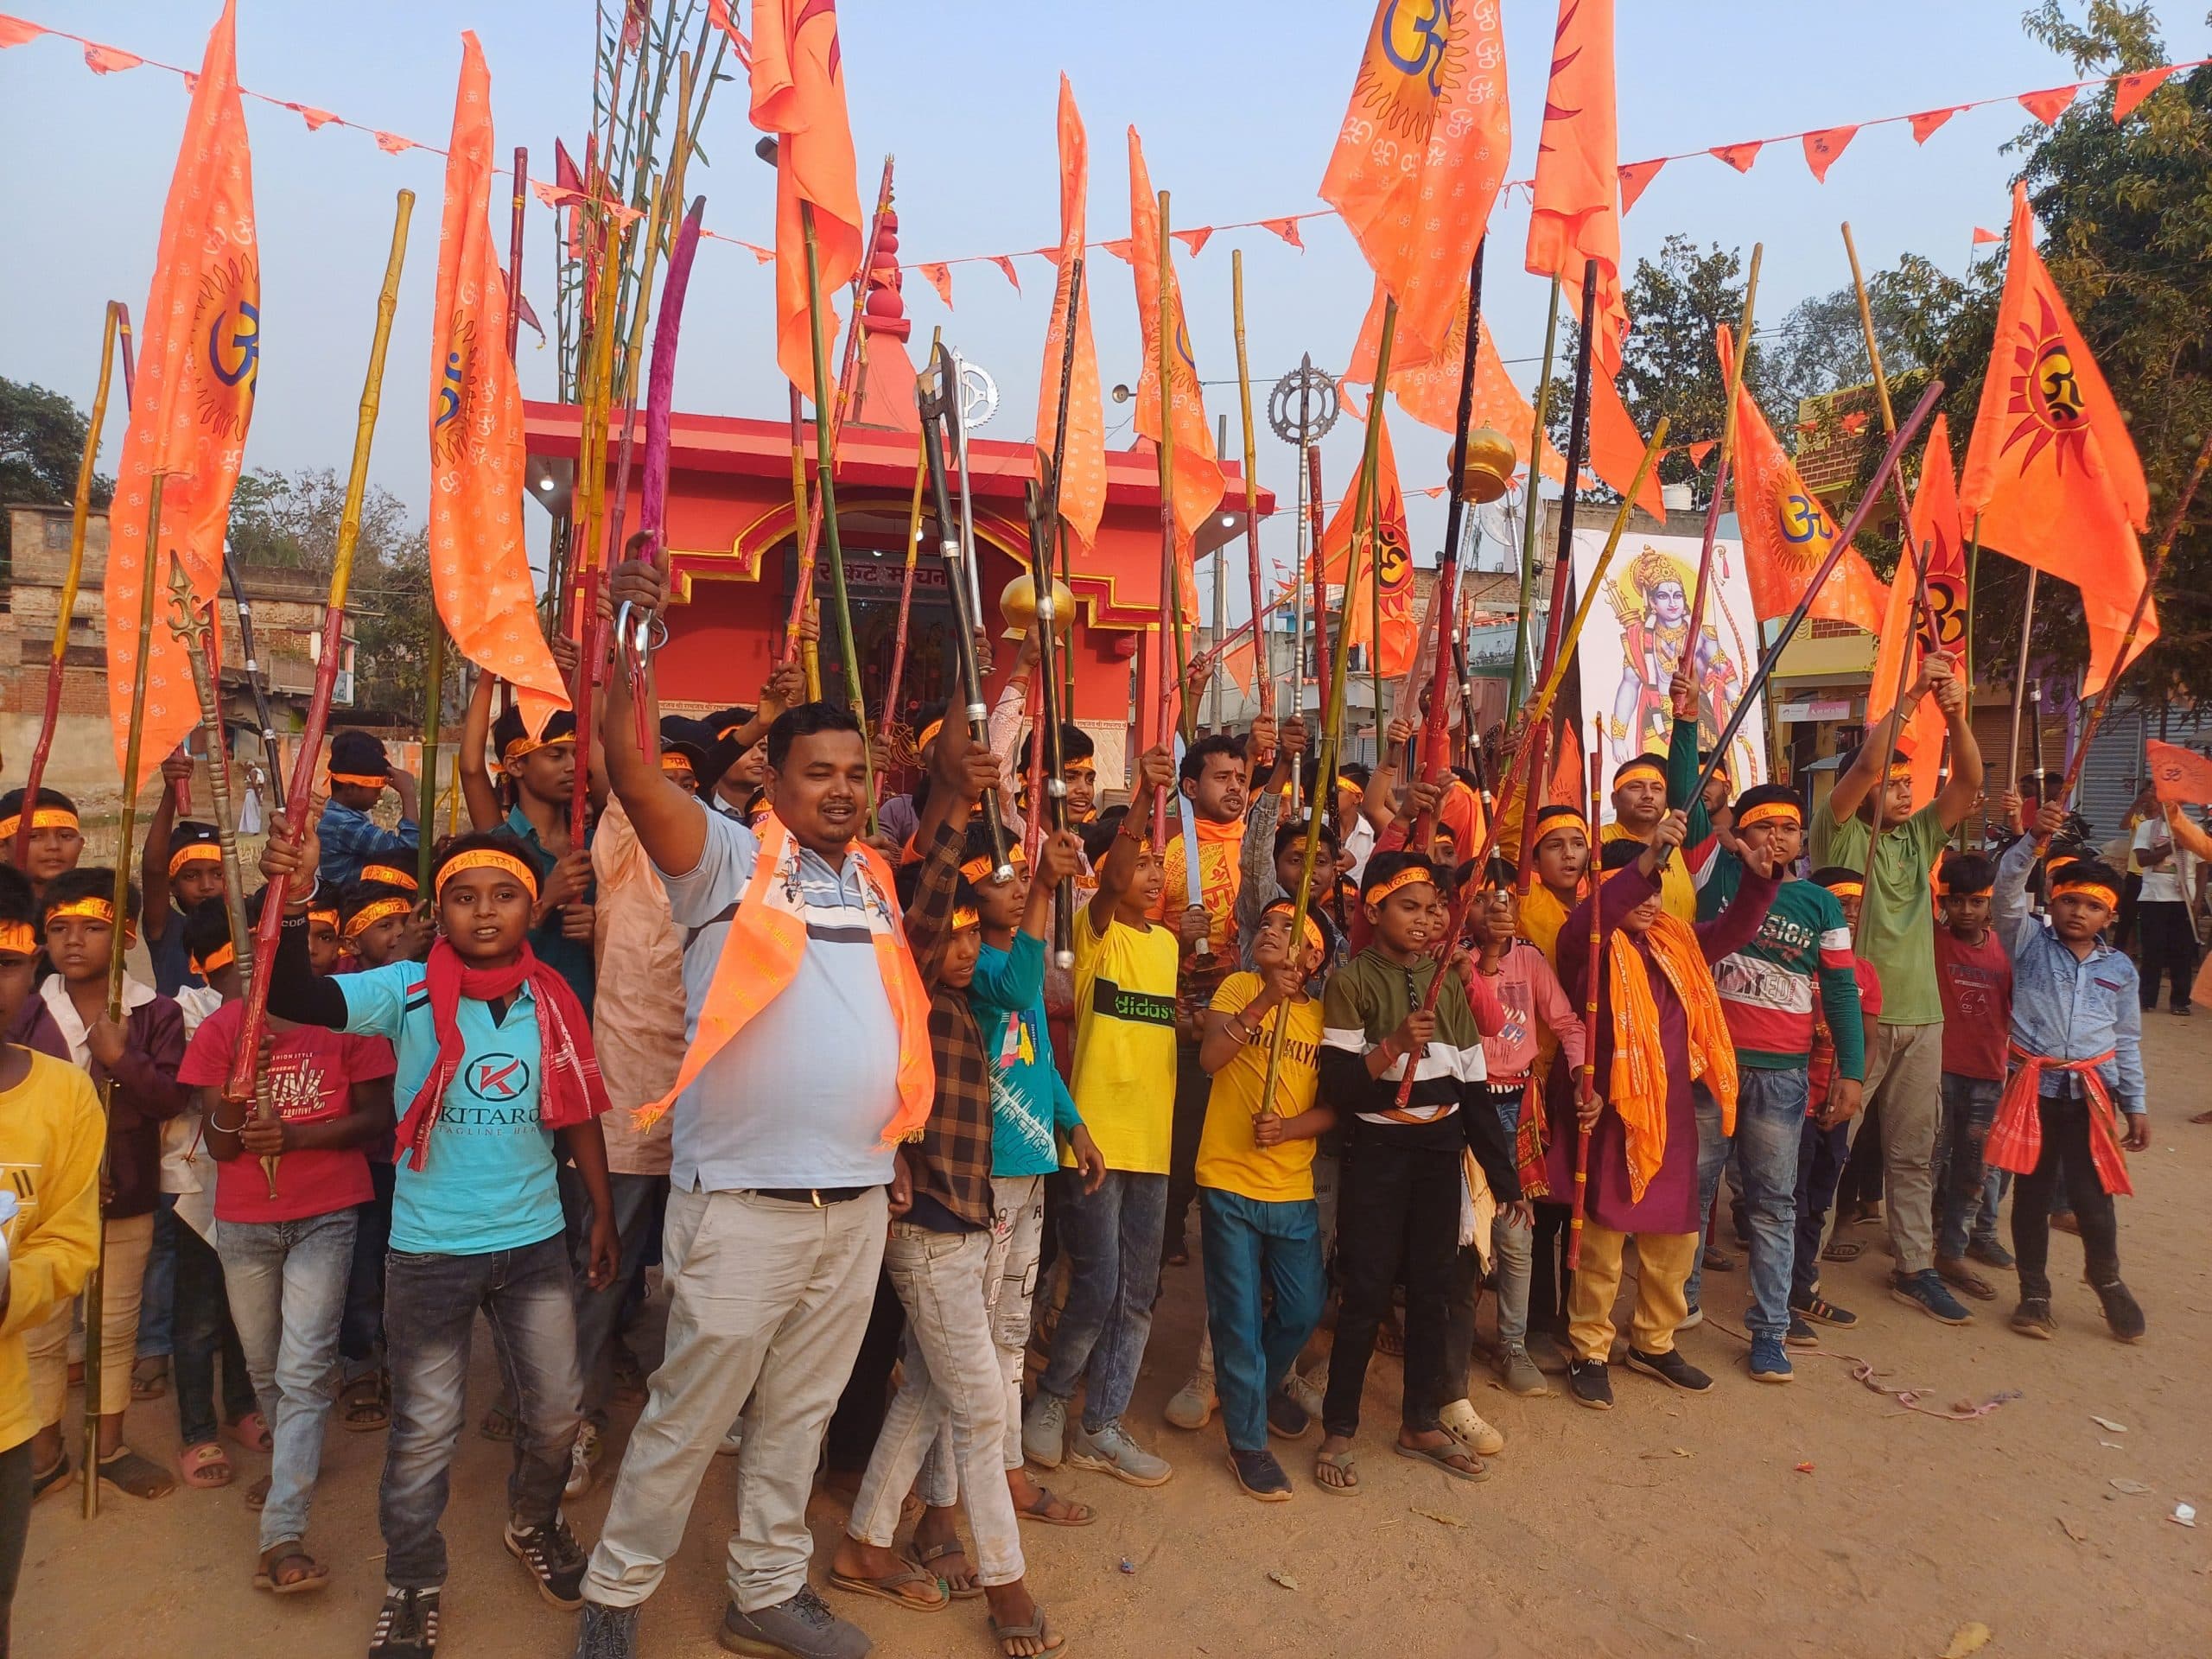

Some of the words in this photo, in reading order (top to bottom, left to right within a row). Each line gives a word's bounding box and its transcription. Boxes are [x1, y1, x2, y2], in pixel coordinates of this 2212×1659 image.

[459, 852, 478, 866] श्री
[439, 1107, 541, 1125] KITARO
[437, 1126, 502, 1136] TAGLINE
